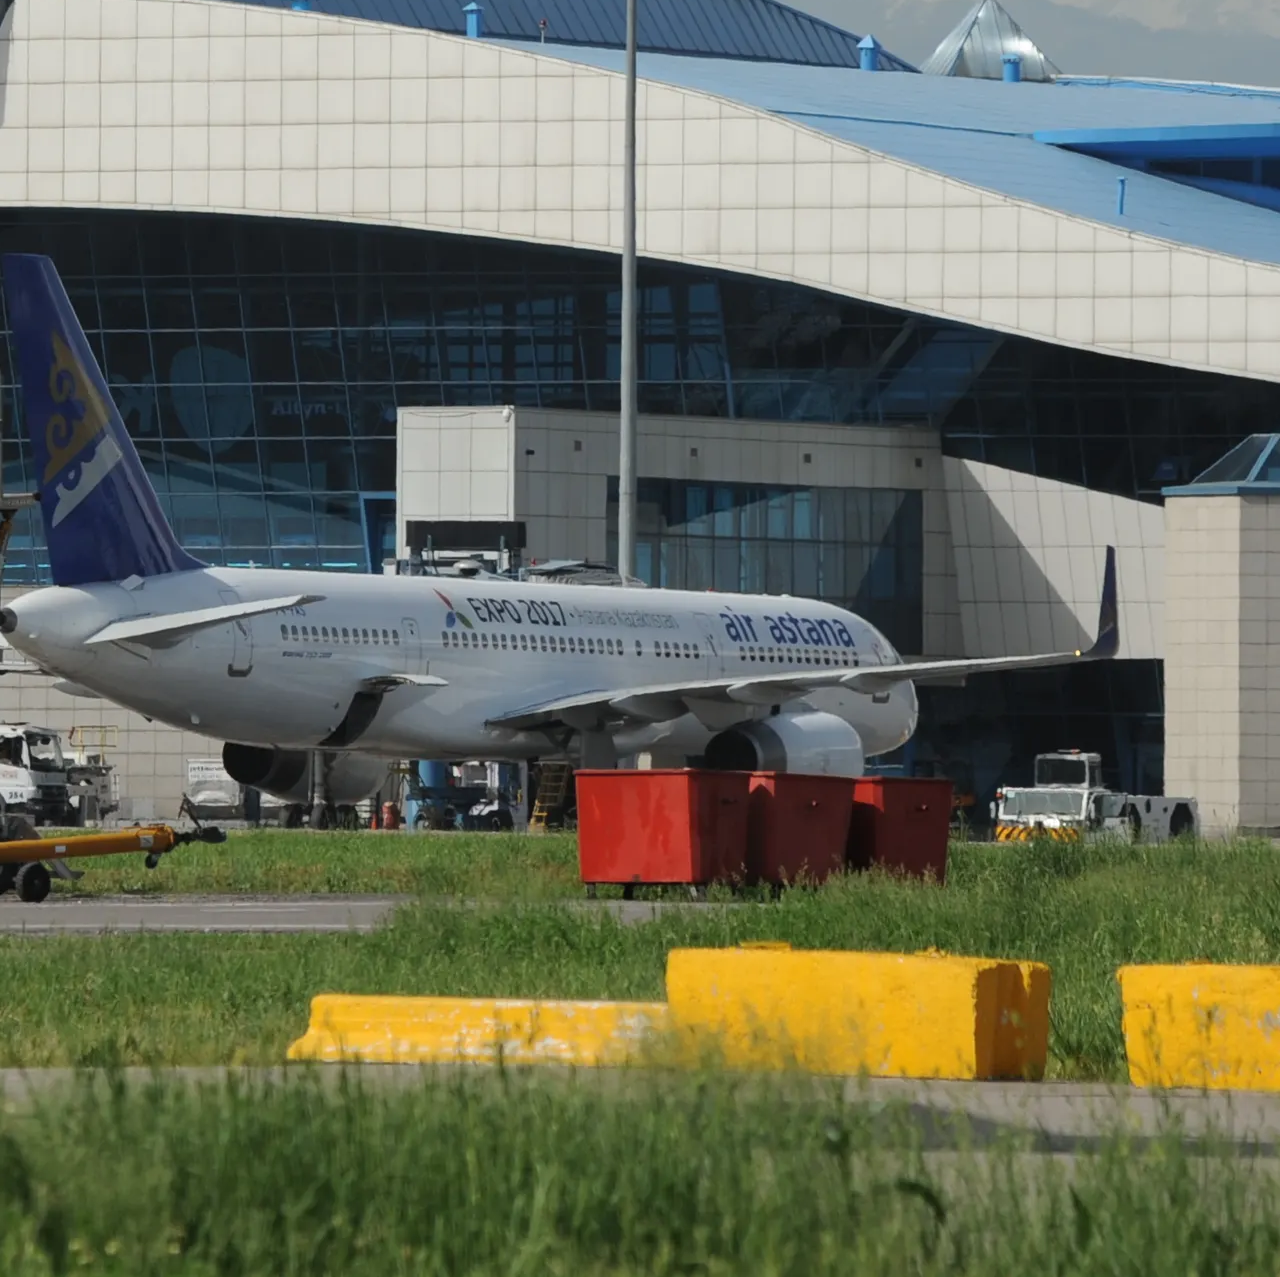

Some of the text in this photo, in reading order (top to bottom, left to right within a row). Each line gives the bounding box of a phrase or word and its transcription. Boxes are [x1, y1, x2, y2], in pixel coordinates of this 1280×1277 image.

[467, 598, 522, 624] EXPO
[517, 599, 567, 626] 2017
[719, 605, 855, 648] air astana
